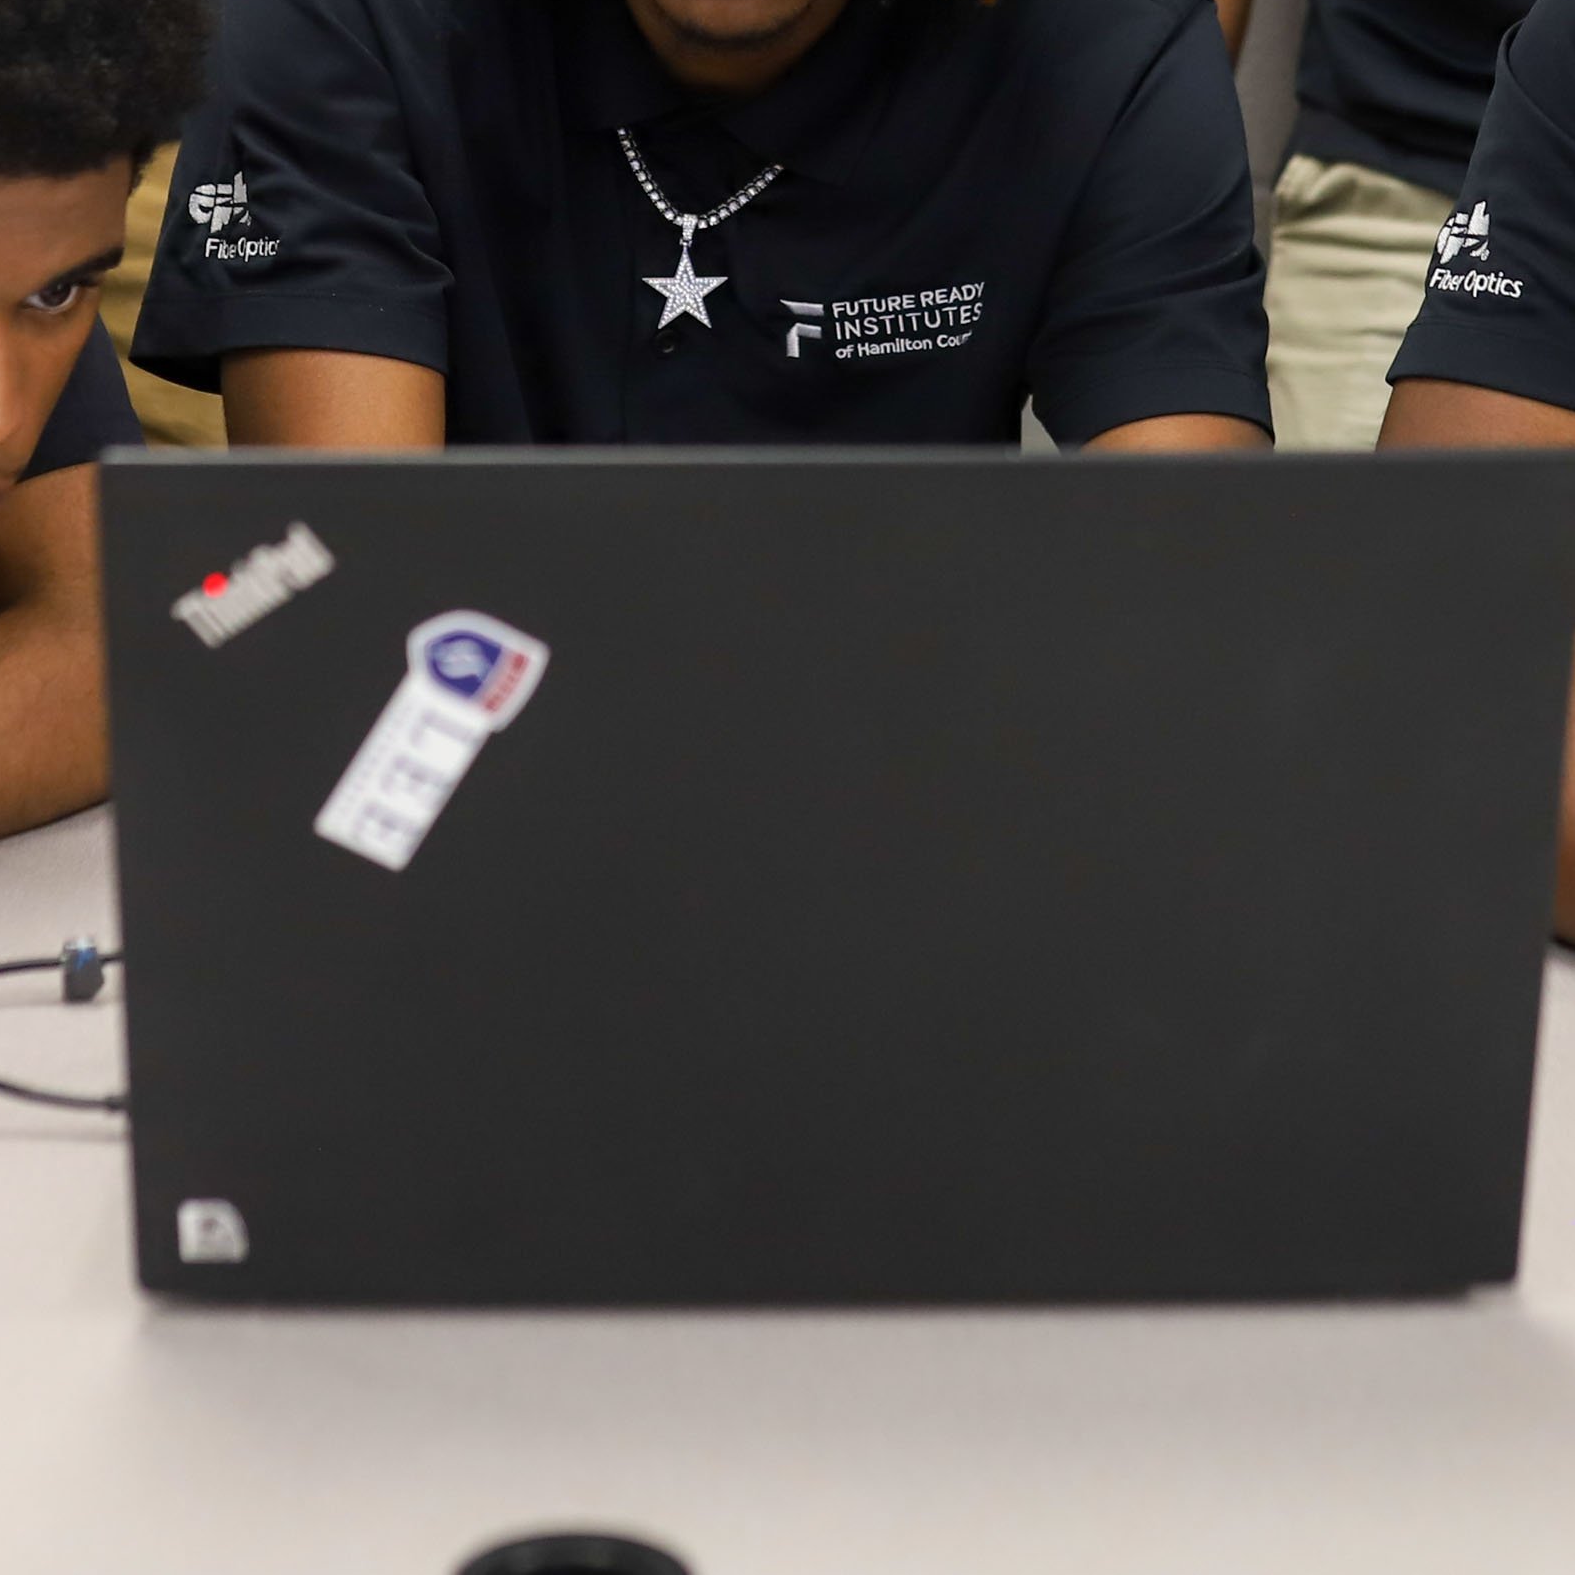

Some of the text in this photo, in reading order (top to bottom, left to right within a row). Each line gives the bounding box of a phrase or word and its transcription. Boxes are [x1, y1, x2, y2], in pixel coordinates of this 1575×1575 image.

[1429, 267, 1523, 298] Fiber Optics
[832, 281, 985, 319] FUTURE READY
[835, 302, 983, 341] INSTITUTES
[835, 344, 855, 359] of
[857, 337, 933, 358] Hamilton
